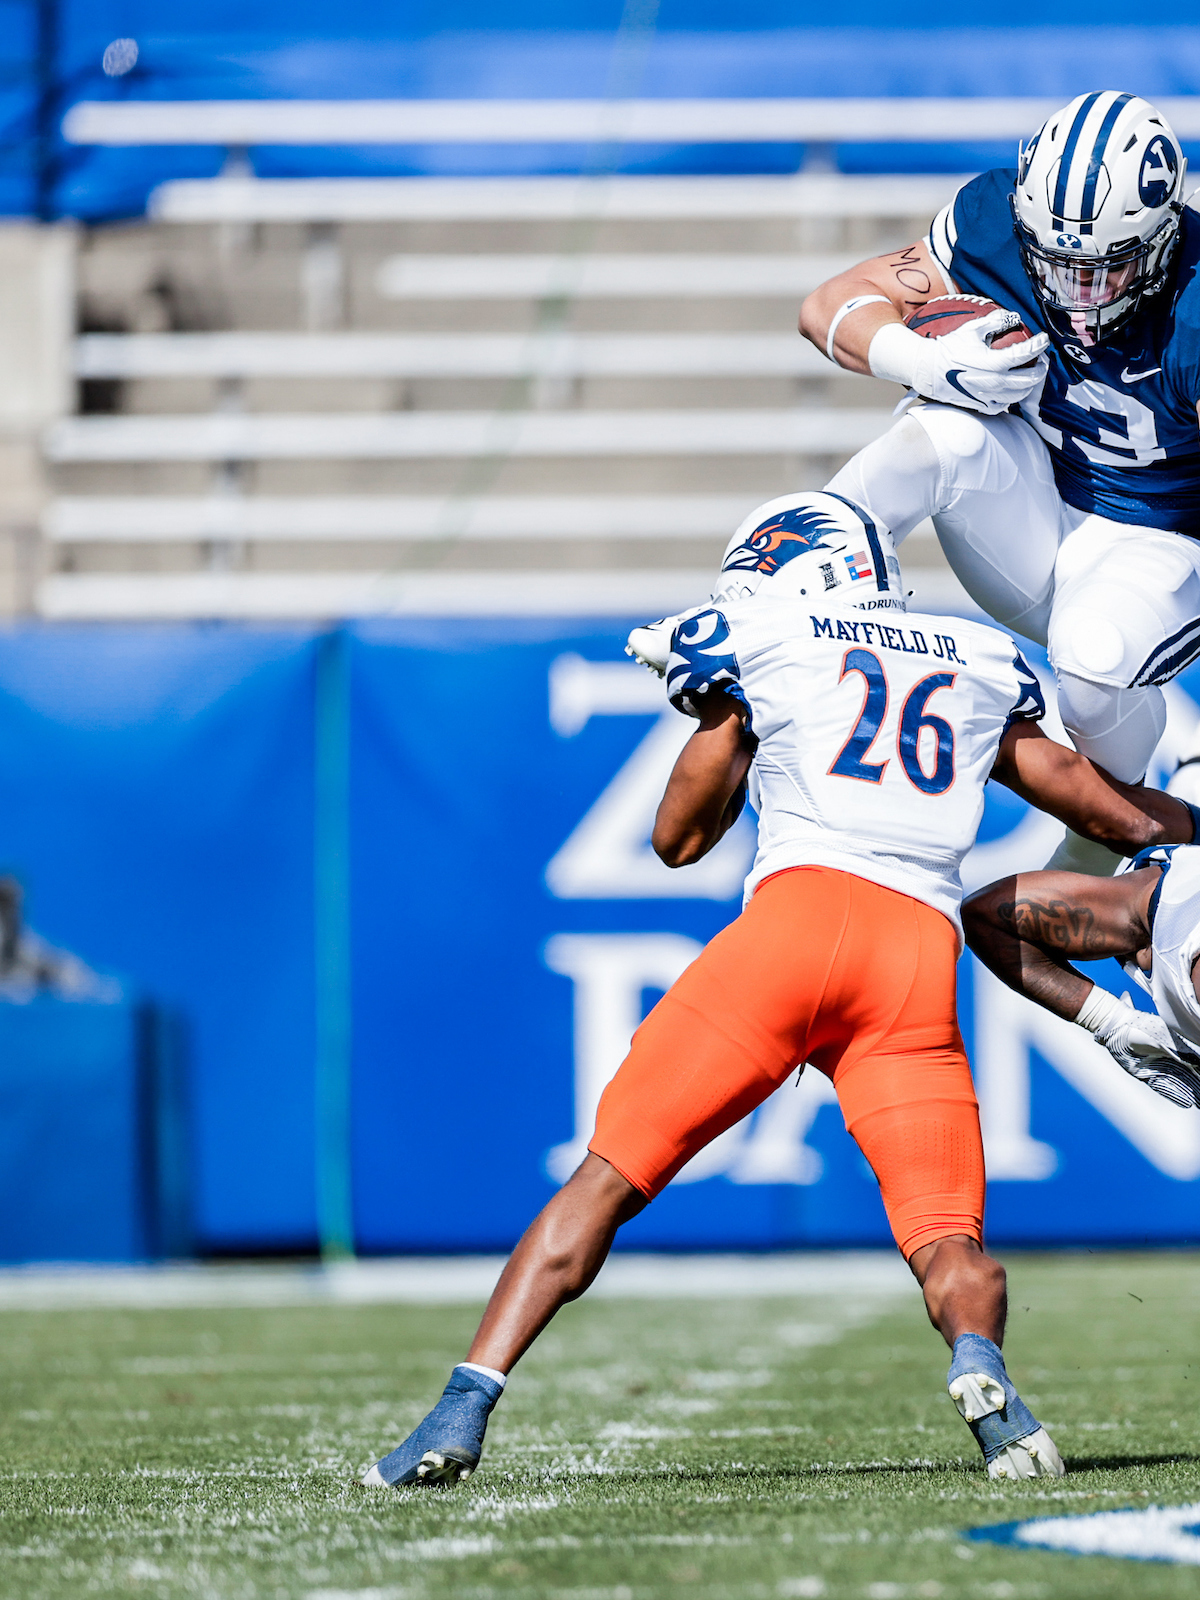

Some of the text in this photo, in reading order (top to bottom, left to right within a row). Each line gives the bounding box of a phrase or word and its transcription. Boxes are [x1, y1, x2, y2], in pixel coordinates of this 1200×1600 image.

[809, 615, 967, 666] MAYFIELD JR.
[826, 646, 958, 797] 26
